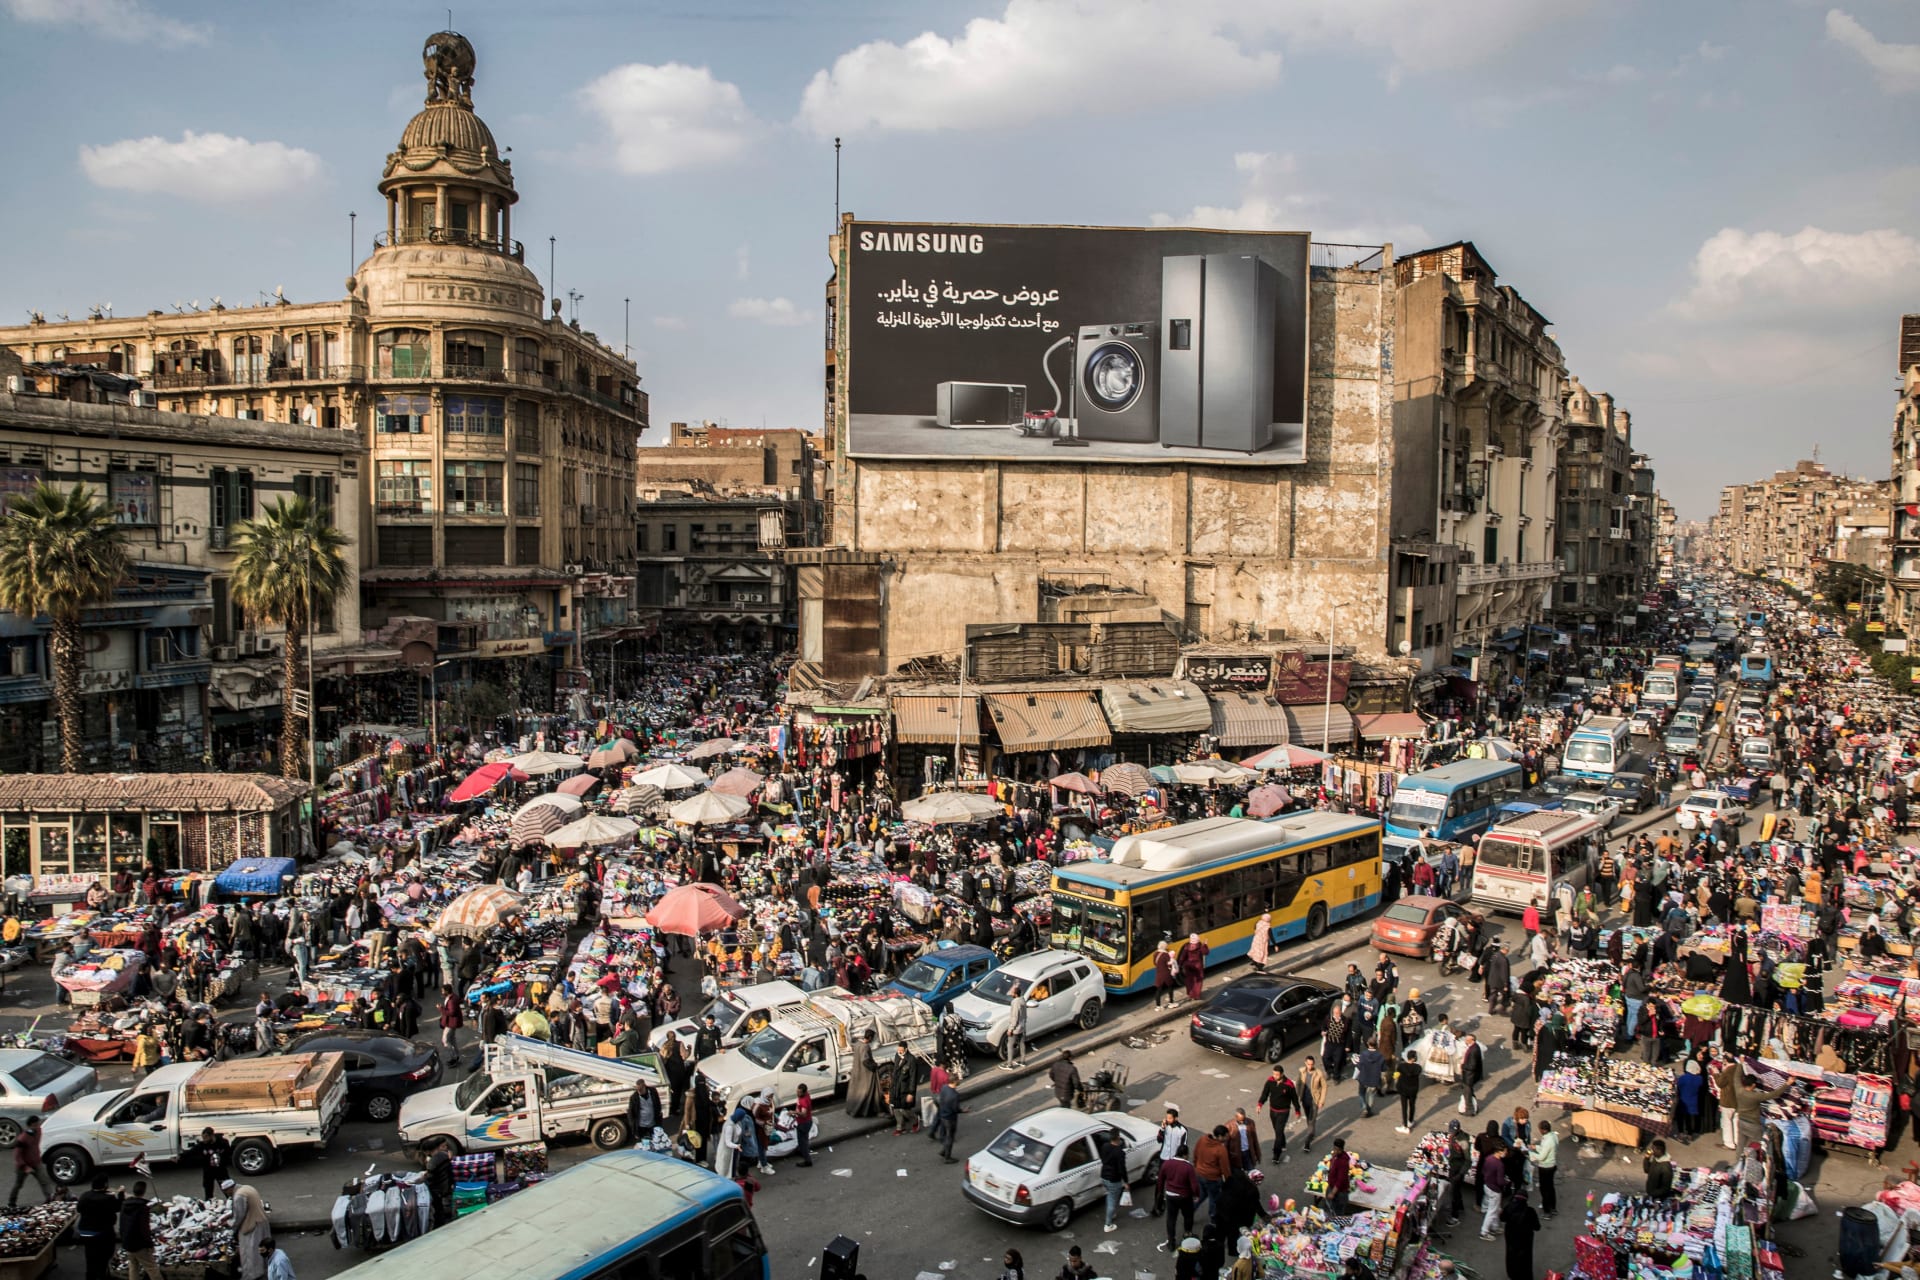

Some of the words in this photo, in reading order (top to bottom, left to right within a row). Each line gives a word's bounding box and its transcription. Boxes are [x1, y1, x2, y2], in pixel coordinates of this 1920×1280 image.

[860, 231, 984, 254] SAMSUNG
[427, 284, 518, 306] TIRING
[922, 279, 939, 308] في
[942, 280, 1000, 305] حصرية
[1002, 285, 1060, 306] عروض
[876, 311, 911, 328] المنزلية
[912, 310, 954, 329] الأجهزة
[956, 312, 1007, 330] تكنولوجيا
[1007, 312, 1041, 328] أحدث
[1042, 319, 1060, 333] مع
[1189, 662, 1268, 681] شعراوي
